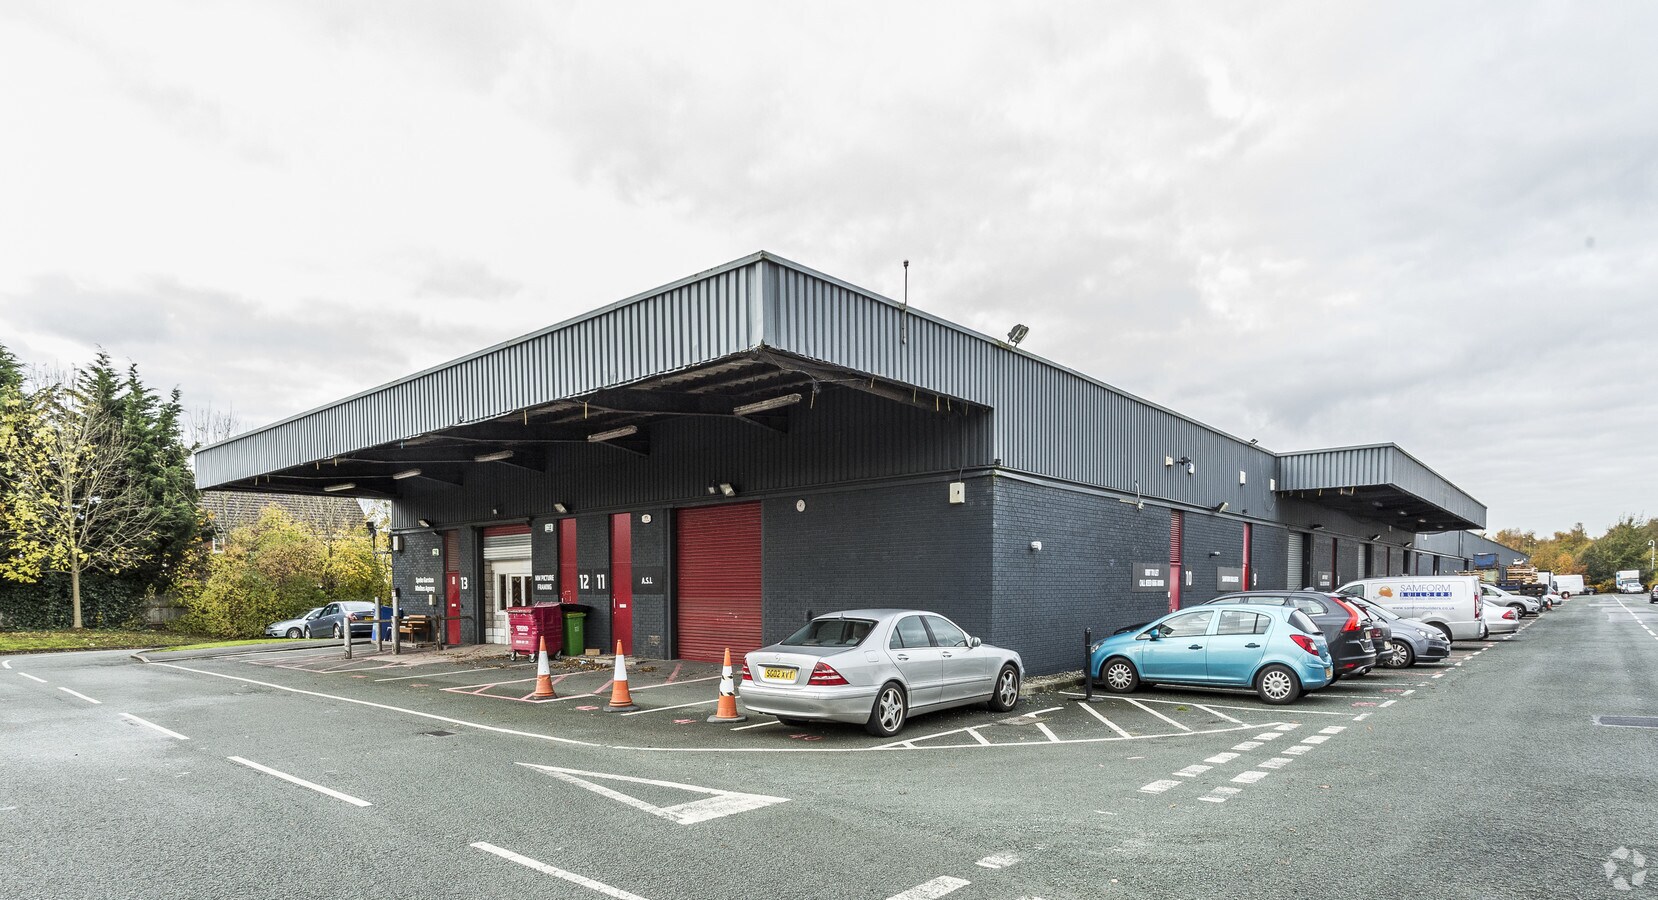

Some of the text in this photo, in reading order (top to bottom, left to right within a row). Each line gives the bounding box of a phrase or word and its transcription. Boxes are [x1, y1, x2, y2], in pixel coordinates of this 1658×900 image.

[460, 576, 468, 590] 13
[579, 574, 589, 589] 12
[596, 574, 606, 589] 11
[1185, 570, 1193, 586] 10
[1253, 572, 1257, 587] 9
